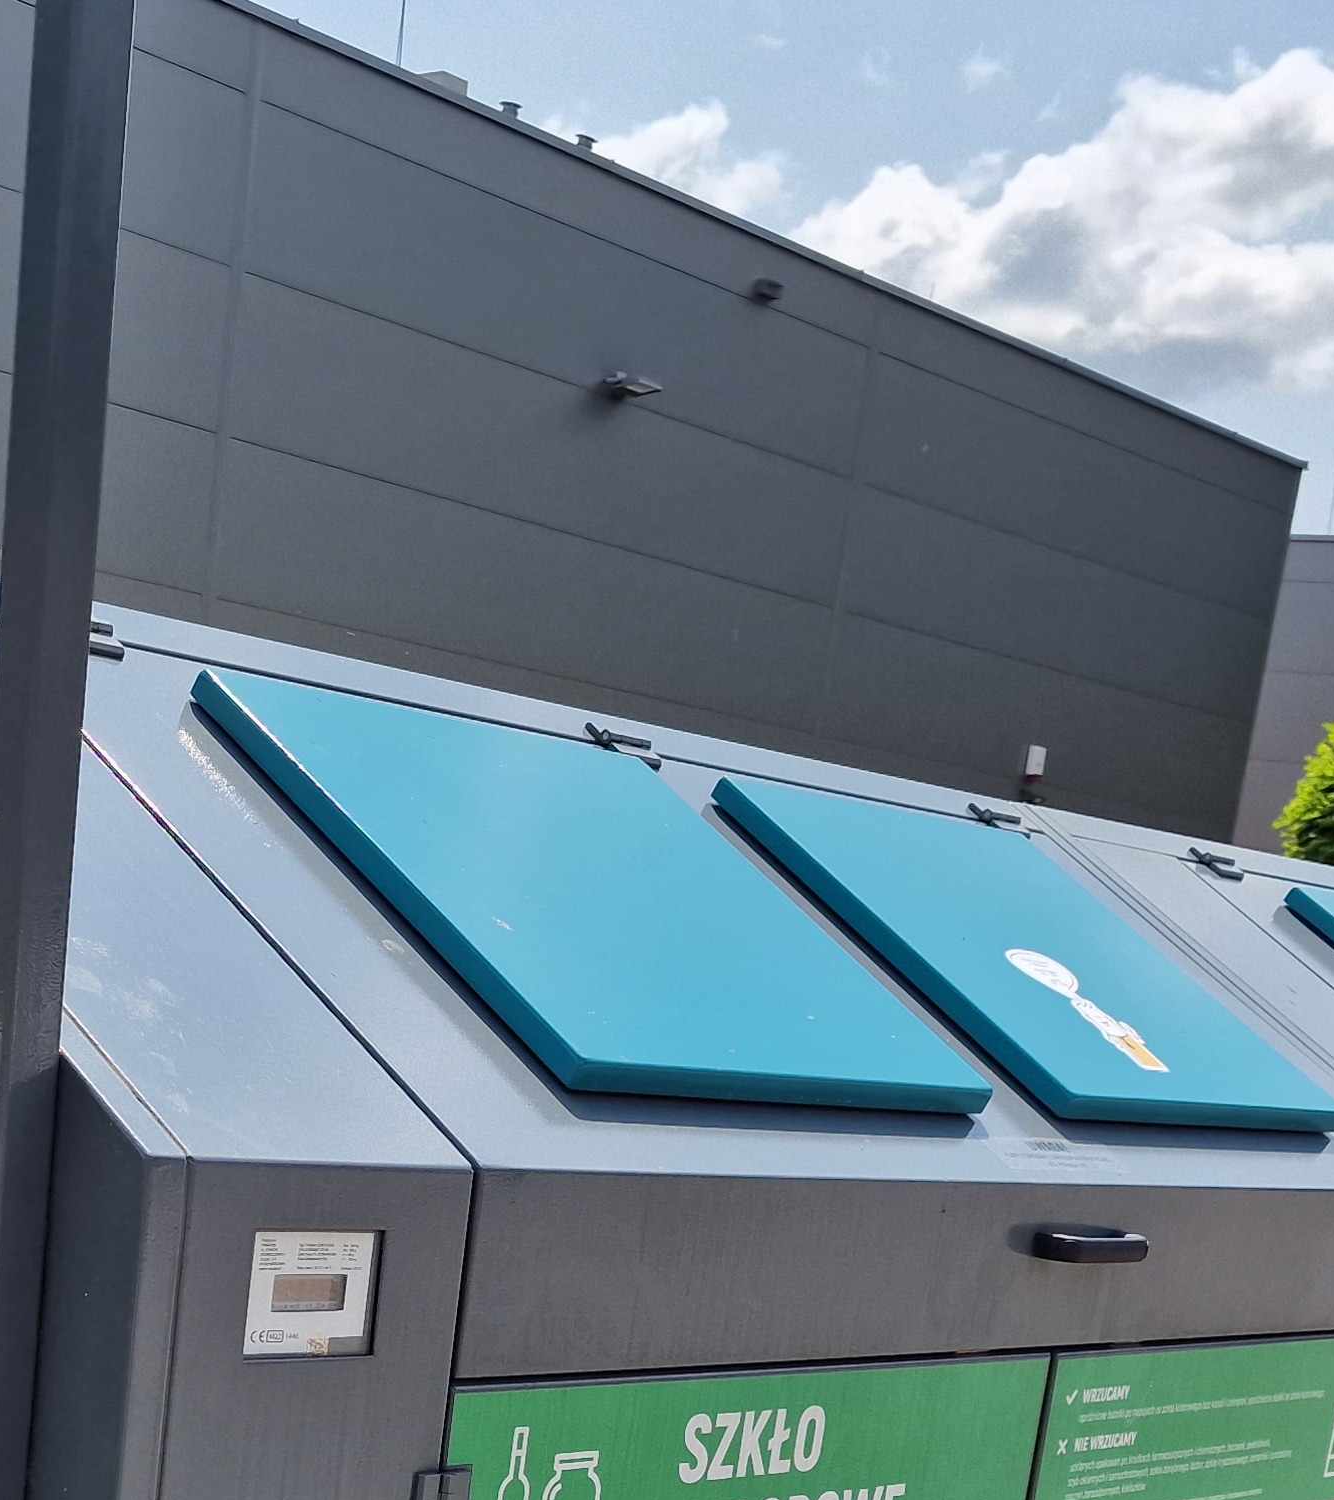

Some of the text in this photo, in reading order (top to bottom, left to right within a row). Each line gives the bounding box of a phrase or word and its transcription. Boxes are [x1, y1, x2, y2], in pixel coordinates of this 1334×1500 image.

[1082, 1385, 1131, 1405] WRZUCAMY
[678, 1404, 827, 1484] SZKŁO
[1073, 1431, 1138, 1453] NIE WRZUCAMY
